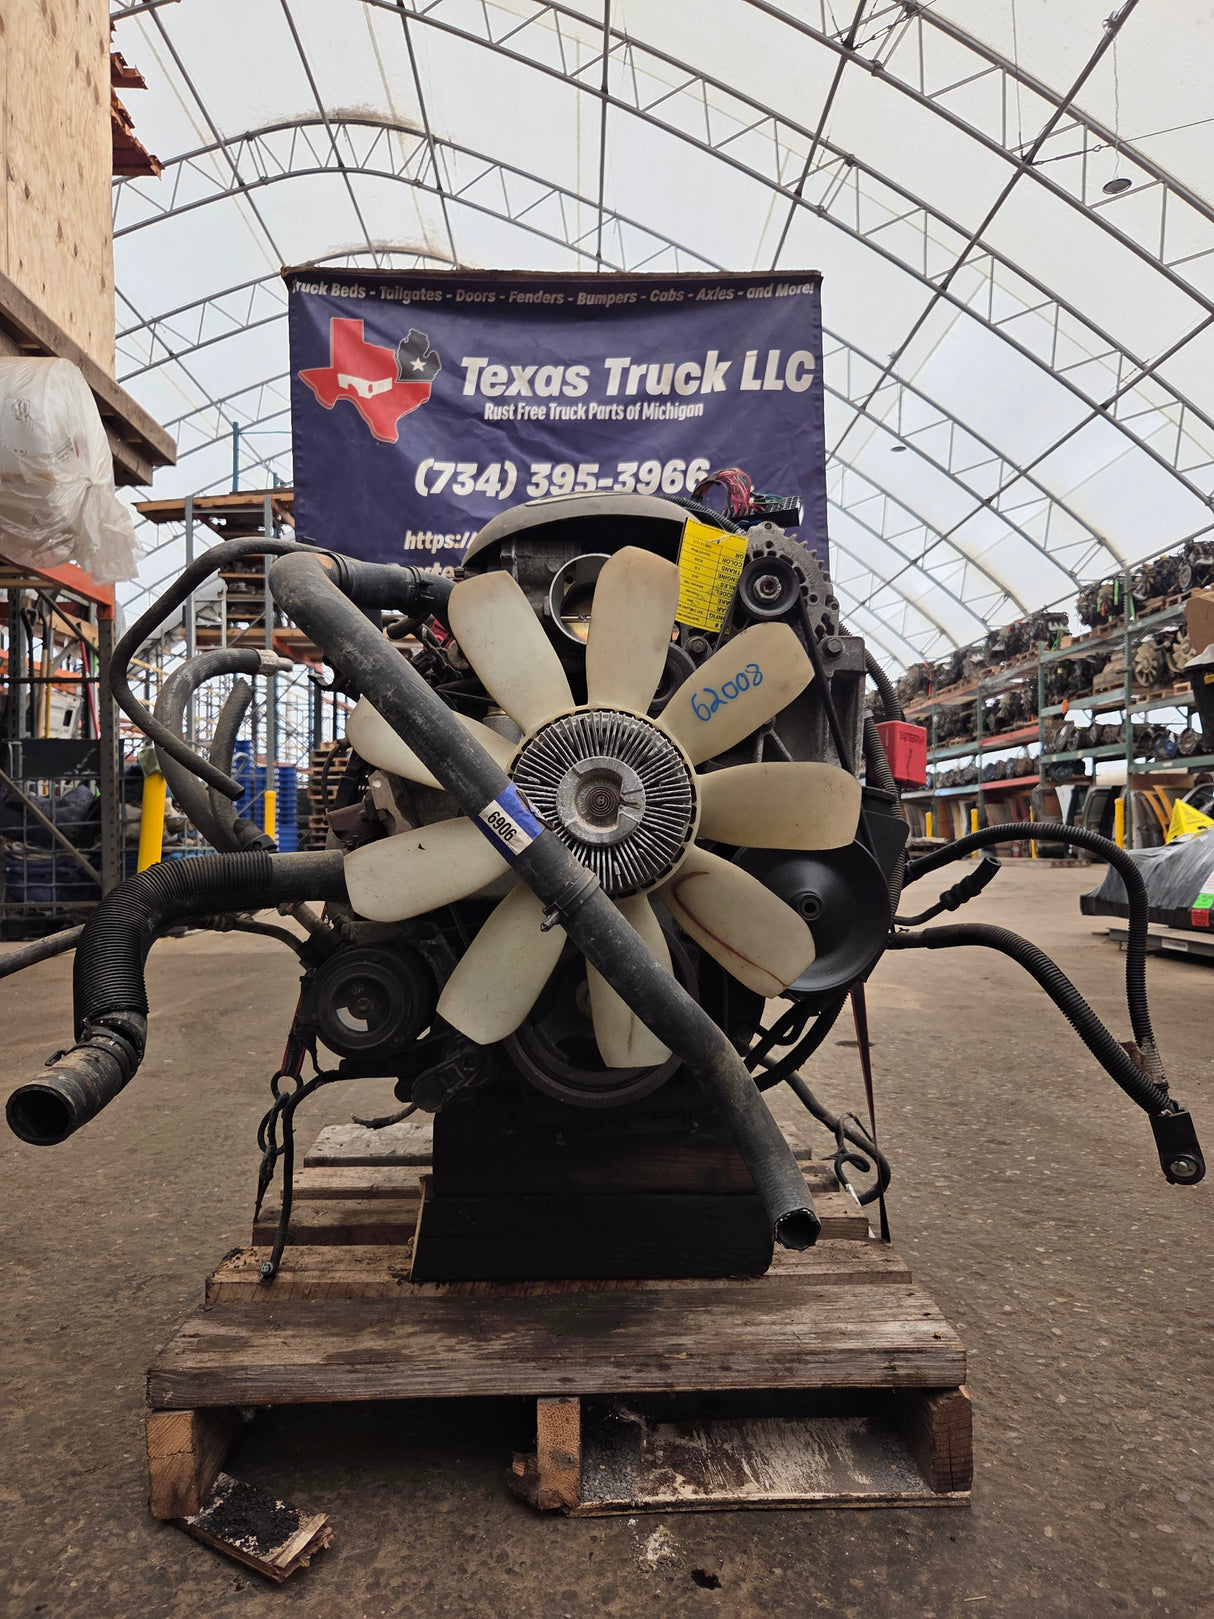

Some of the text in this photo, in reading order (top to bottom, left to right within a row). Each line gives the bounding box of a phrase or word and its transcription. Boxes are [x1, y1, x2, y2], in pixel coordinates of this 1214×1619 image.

[330, 283, 366, 298] Beds
[380, 286, 442, 304] Tailgates
[456, 289, 496, 302] Doors
[508, 290, 564, 304] Fenders
[577, 291, 637, 307] Bumpers
[650, 288, 684, 302] Cabs
[696, 286, 734, 301] Axles
[746, 283, 771, 298] and
[775, 282, 815, 297] More!
[461, 349, 815, 397] Texas Truck LLC
[484, 402, 704, 420] Rust Free Truck Parts of Michigan
[414, 458, 710, 500] (734) 395-3966
[721, 565, 740, 576] TRANS
[722, 557, 743, 568] COLOR
[691, 663, 763, 721] 62008
[487, 811, 517, 841] 6906
